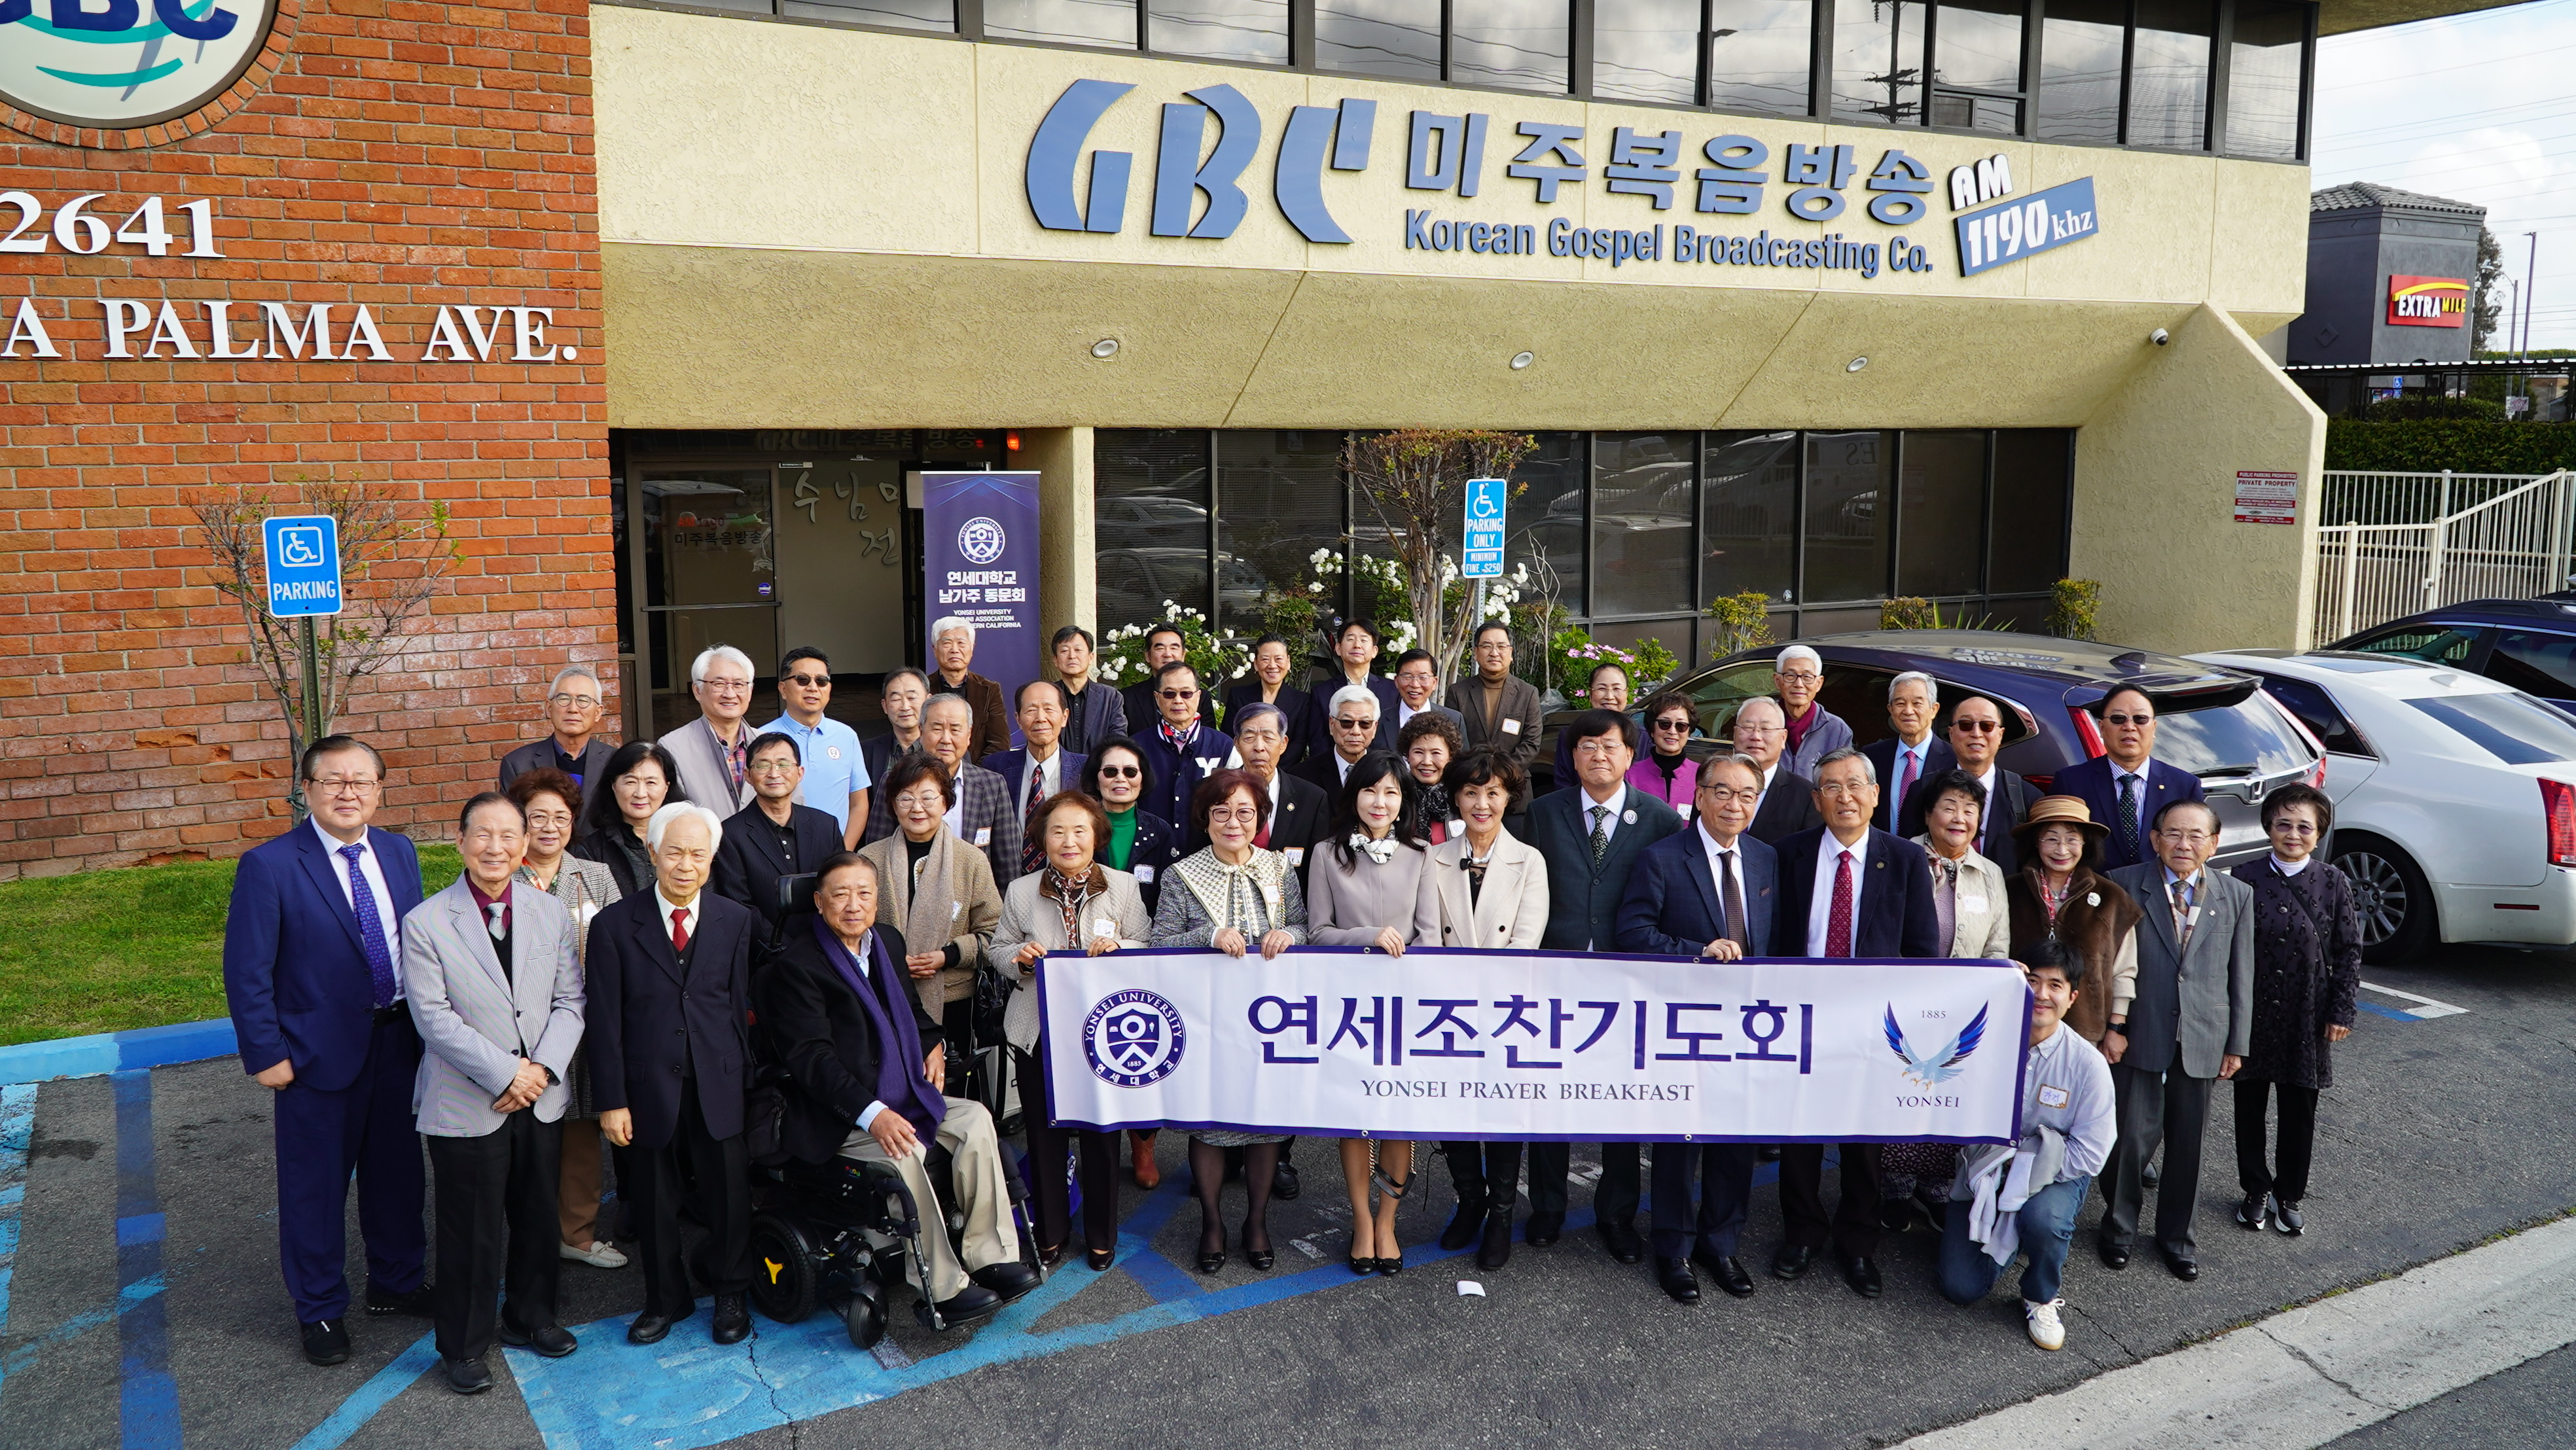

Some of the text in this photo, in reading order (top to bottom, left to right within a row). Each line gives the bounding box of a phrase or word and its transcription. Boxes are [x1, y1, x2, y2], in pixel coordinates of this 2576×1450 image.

[1026, 78, 1377, 244] GBC
[1405, 110, 1935, 225] 미주복음방송
[1948, 153, 2014, 211] AM
[0, 191, 226, 258] 2641
[1965, 199, 2094, 268] 1190 khz
[1405, 208, 1933, 279] Korean Gospel Broadcasting Co.
[2398, 294, 2467, 318] EXTRA MILE
[98, 299, 394, 361] PALMA
[421, 304, 578, 362] AVE.
[1467, 518, 1503, 533] PARKING
[675, 531, 762, 547] 미주복음방송
[1473, 533, 1496, 548] ONLY
[1466, 563, 1480, 573] FINE
[1470, 552, 1497, 562] MINIMUM
[947, 571, 1017, 586] 연세대학교
[272, 580, 336, 601] PARKING
[939, 588, 1026, 603] 남가주 동문회
[1084, 992, 1183, 1041] YONSEI UNIVERSITY
[1921, 1010, 1947, 1019] 1885
[1247, 995, 1814, 1074] 연세조찬기도회
[1361, 1080, 1695, 1102] YONSEI PRAYER BREAKFAST
[1895, 1095, 1960, 1108] YONSEI
